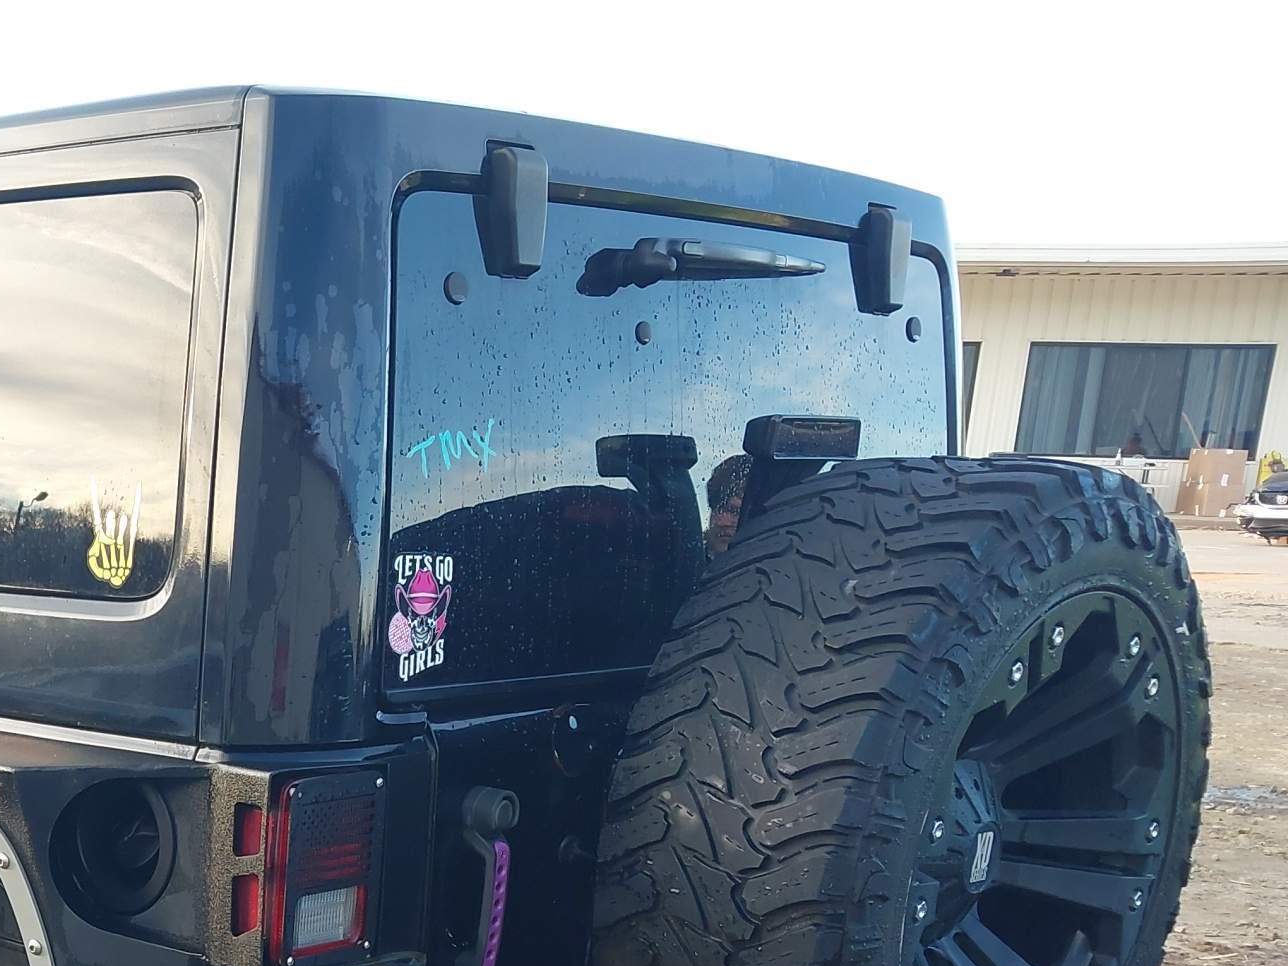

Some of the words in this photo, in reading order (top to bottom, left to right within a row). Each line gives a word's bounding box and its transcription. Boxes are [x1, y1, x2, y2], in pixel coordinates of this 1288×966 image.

[394, 553, 433, 585] LET'S
[435, 556, 454, 585] GO
[398, 639, 445, 682] GIRLS
